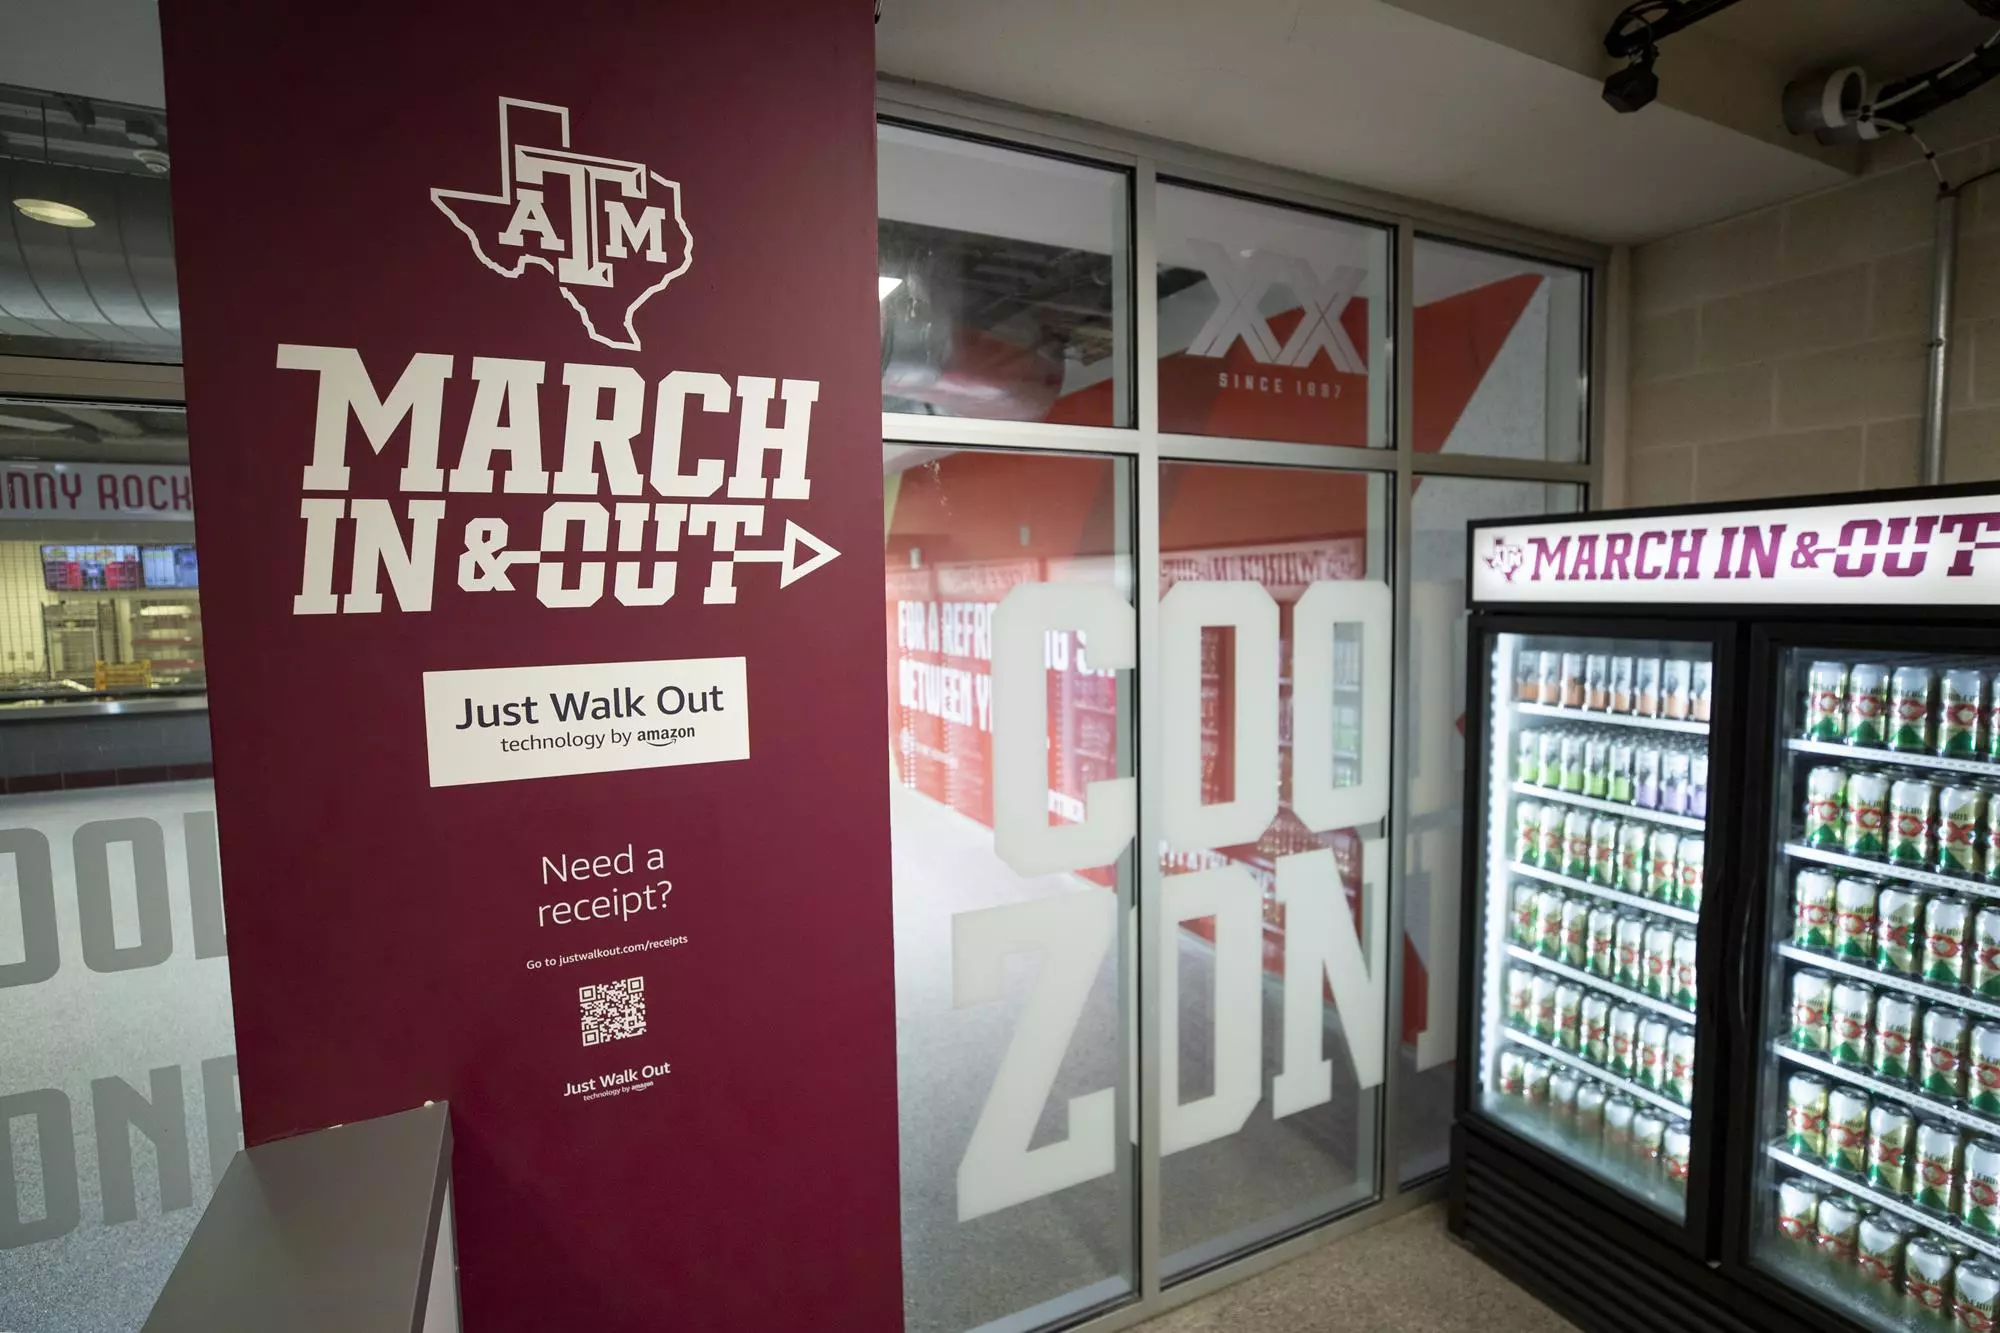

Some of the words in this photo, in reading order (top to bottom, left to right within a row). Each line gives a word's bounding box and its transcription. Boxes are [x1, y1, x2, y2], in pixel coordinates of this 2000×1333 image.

[1219, 372, 1283, 394] SINCE
[276, 343, 820, 500] MARCH
[0, 472, 82, 510] NNY
[293, 498, 446, 615] IN
[457, 517, 516, 592] &
[536, 501, 765, 608] OUT
[1527, 529, 1707, 581] MARCH
[1713, 524, 1788, 579] IN
[1791, 531, 1820, 569] &
[1833, 513, 2000, 578] OUT
[455, 695, 540, 730] Just
[549, 686, 647, 722] Walk
[656, 685, 724, 715] Out
[500, 731, 606, 752] technology
[611, 728, 632, 747] by
[637, 726, 696, 746] amazon
[541, 843, 635, 885] Need
[646, 848, 664, 871] a
[538, 880, 673, 928] receipt?
[526, 960, 542, 970] Go
[545, 957, 557, 967] to
[559, 935, 689, 967] justwalkout.com/receipts
[563, 1078, 596, 1097] Just
[599, 1068, 639, 1088] Walk
[641, 1062, 671, 1079] Out
[583, 1088, 621, 1102] technology
[621, 1086, 631, 1094] by
[631, 1081, 654, 1092] amazon
